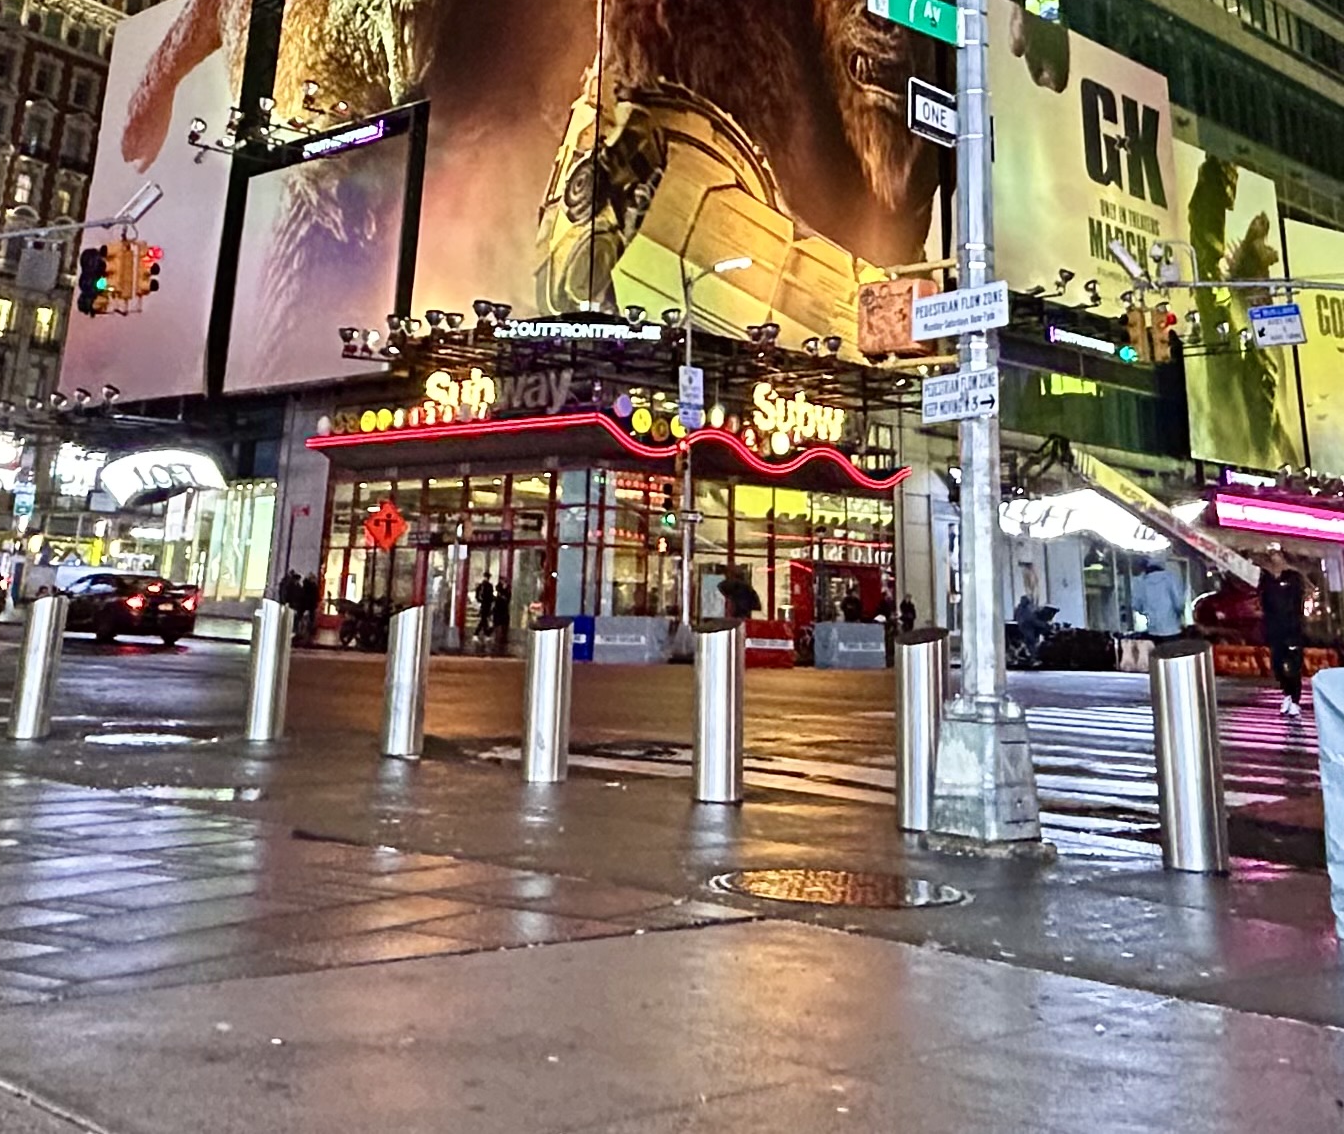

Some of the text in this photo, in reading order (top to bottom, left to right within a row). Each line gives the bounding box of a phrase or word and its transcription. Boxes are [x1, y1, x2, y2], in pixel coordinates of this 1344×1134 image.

[922, 101, 948, 129] ONE
[915, 289, 1004, 320] PEDESTRIAN FLOW ZONE
[424, 366, 574, 415] Subway
[924, 370, 996, 398] PEDESTRIAN FLOW ZONE
